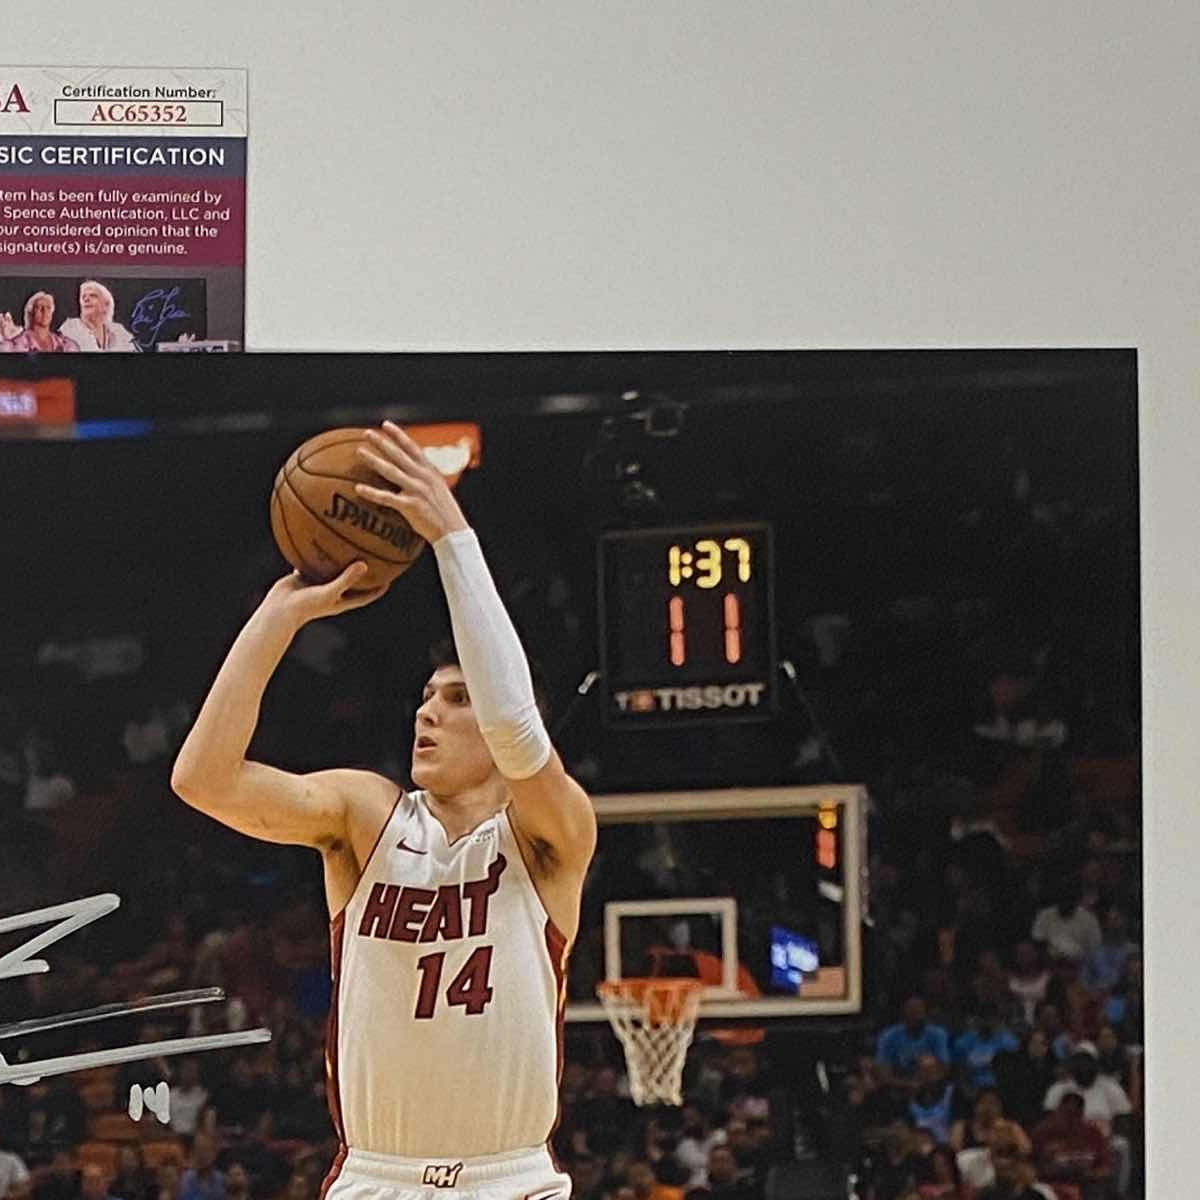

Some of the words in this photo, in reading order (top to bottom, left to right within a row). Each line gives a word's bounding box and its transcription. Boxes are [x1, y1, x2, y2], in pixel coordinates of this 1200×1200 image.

[62, 84, 150, 98] Certification
[155, 86, 216, 99] Number:
[91, 104, 187, 122] AC65352
[41, 147, 225, 166] CERTIFICATION
[30, 189, 55, 201] has
[59, 189, 94, 202] been
[98, 190, 128, 204] fully
[132, 190, 200, 203] examined
[204, 190, 222, 205] by
[3, 206, 56, 220] Spence
[60, 207, 168, 221] Authentication,
[172, 208, 199, 220] LLC
[203, 208, 230, 221] and
[23, 224, 100, 237] considered
[104, 225, 157, 238] opinion
[162, 224, 191, 237] that
[194, 225, 218, 238] the
[84, 241, 124, 255] is/are
[128, 243, 188, 256] genuine.
[668, 538, 751, 589] 1:37
[358, 852, 507, 944] HEAT
[414, 945, 494, 1019] 14
